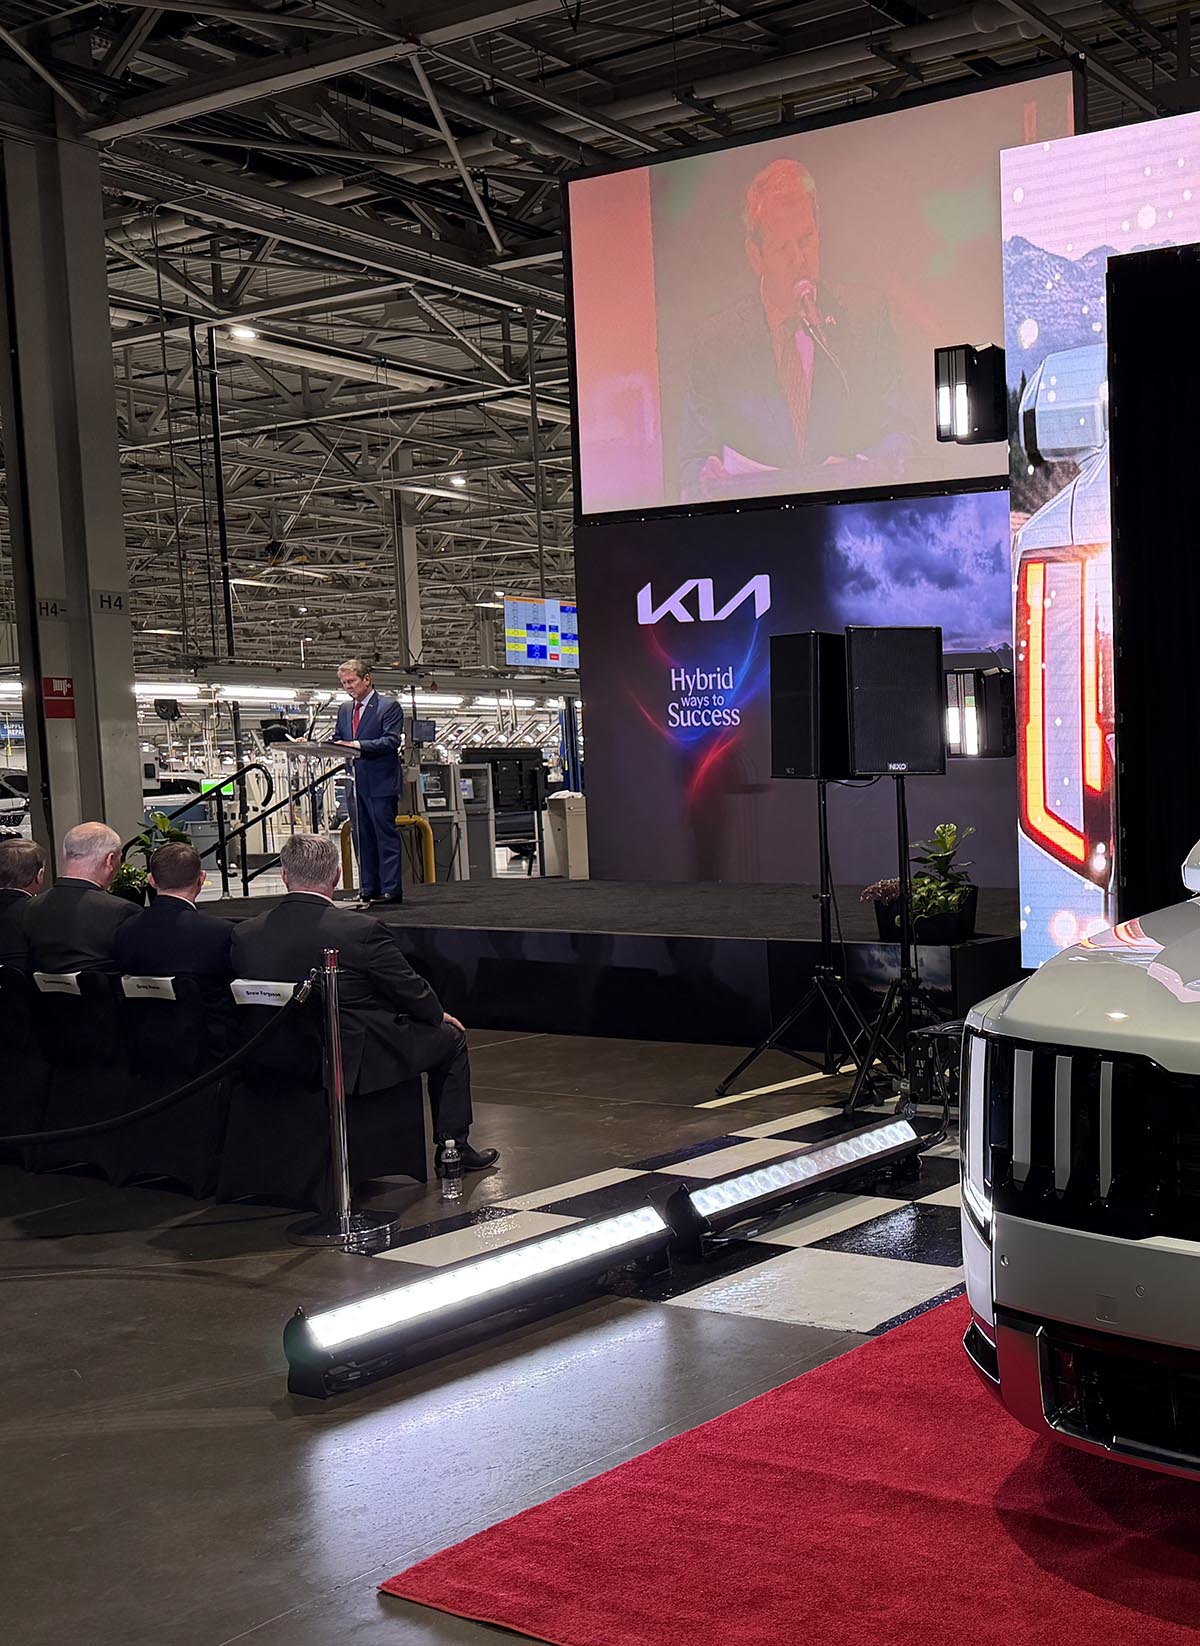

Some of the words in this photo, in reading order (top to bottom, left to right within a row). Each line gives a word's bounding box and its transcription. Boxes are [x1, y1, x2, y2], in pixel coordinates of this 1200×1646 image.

[99, 593, 124, 611] H4
[636, 573, 772, 626] KIA
[670, 665, 734, 697] Hybrid
[680, 694, 710, 709] ways
[712, 693, 725, 707] to
[667, 702, 741, 728] Success
